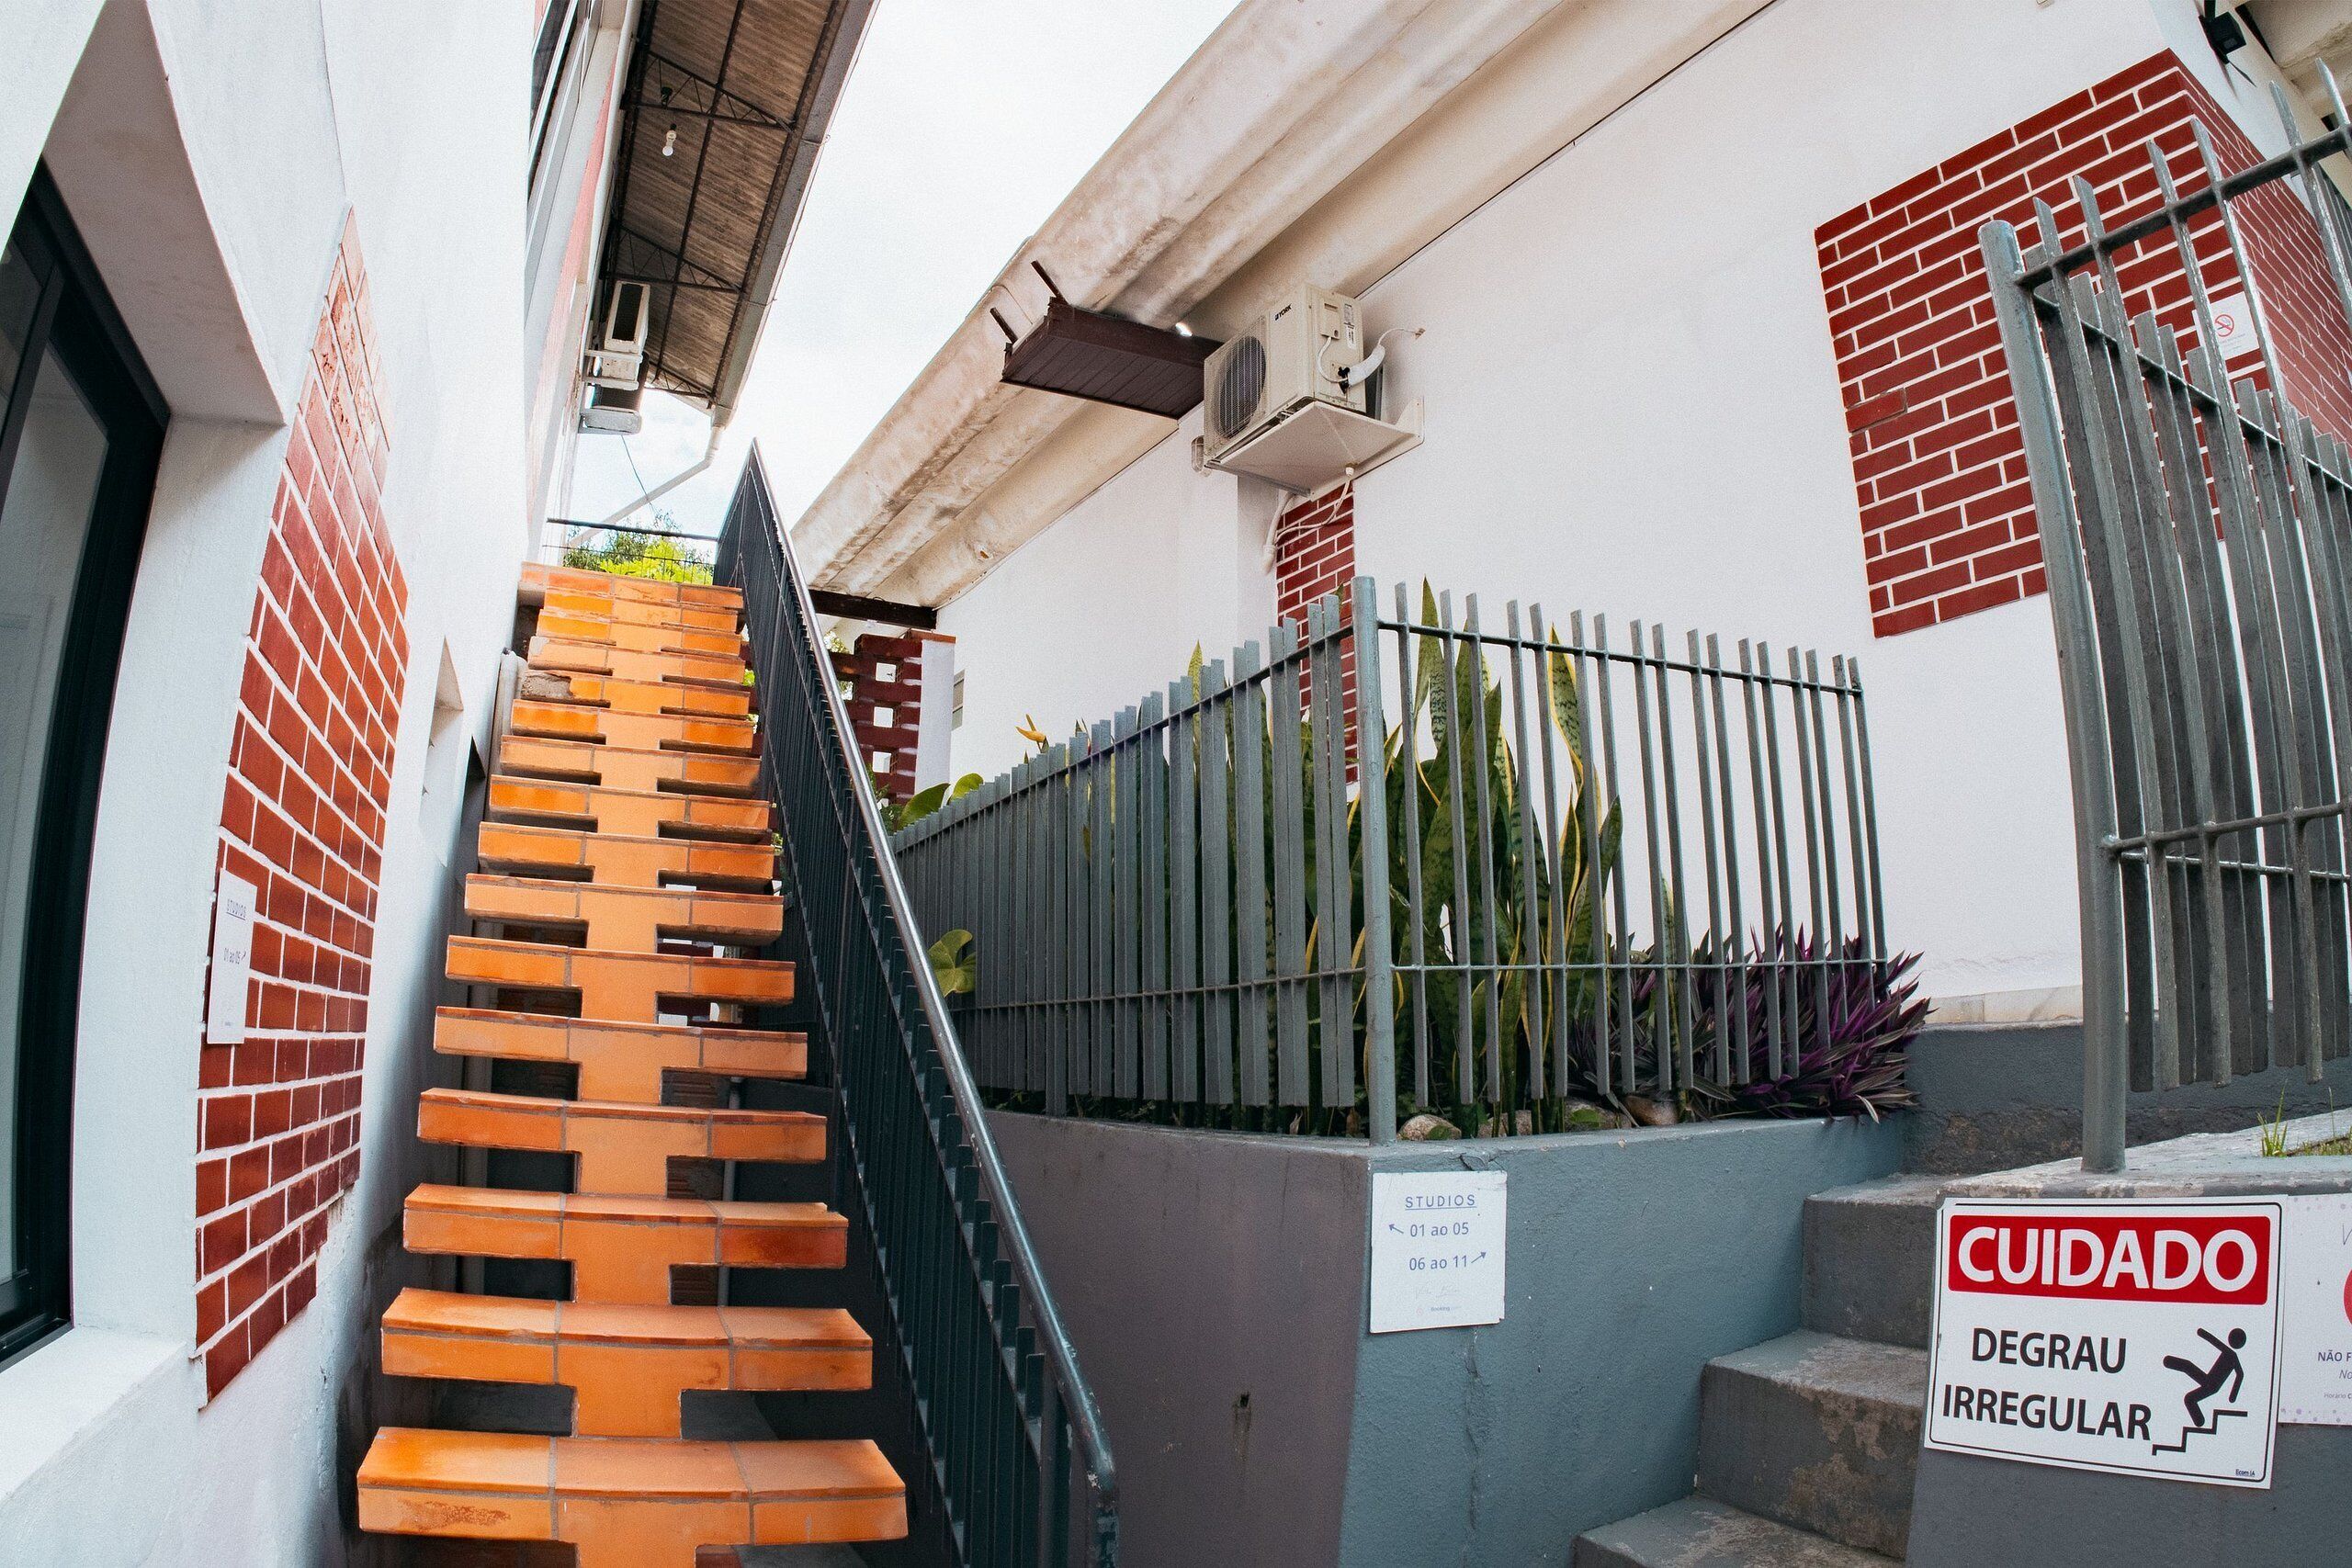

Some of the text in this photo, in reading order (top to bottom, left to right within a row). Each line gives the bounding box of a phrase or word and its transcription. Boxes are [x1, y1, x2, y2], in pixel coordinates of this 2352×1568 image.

[1405, 1194, 1476, 1208] STUDIOS
[1410, 1222, 1469, 1237] 01 ao 05
[1409, 1255, 1467, 1270] 06 ao 11
[1958, 1225, 2257, 1292] CUIDADO
[1972, 1327, 2127, 1374] DEGRAU
[2317, 1349, 2343, 1362] NÃO
[1942, 1384, 2152, 1441] IRREGULAR
